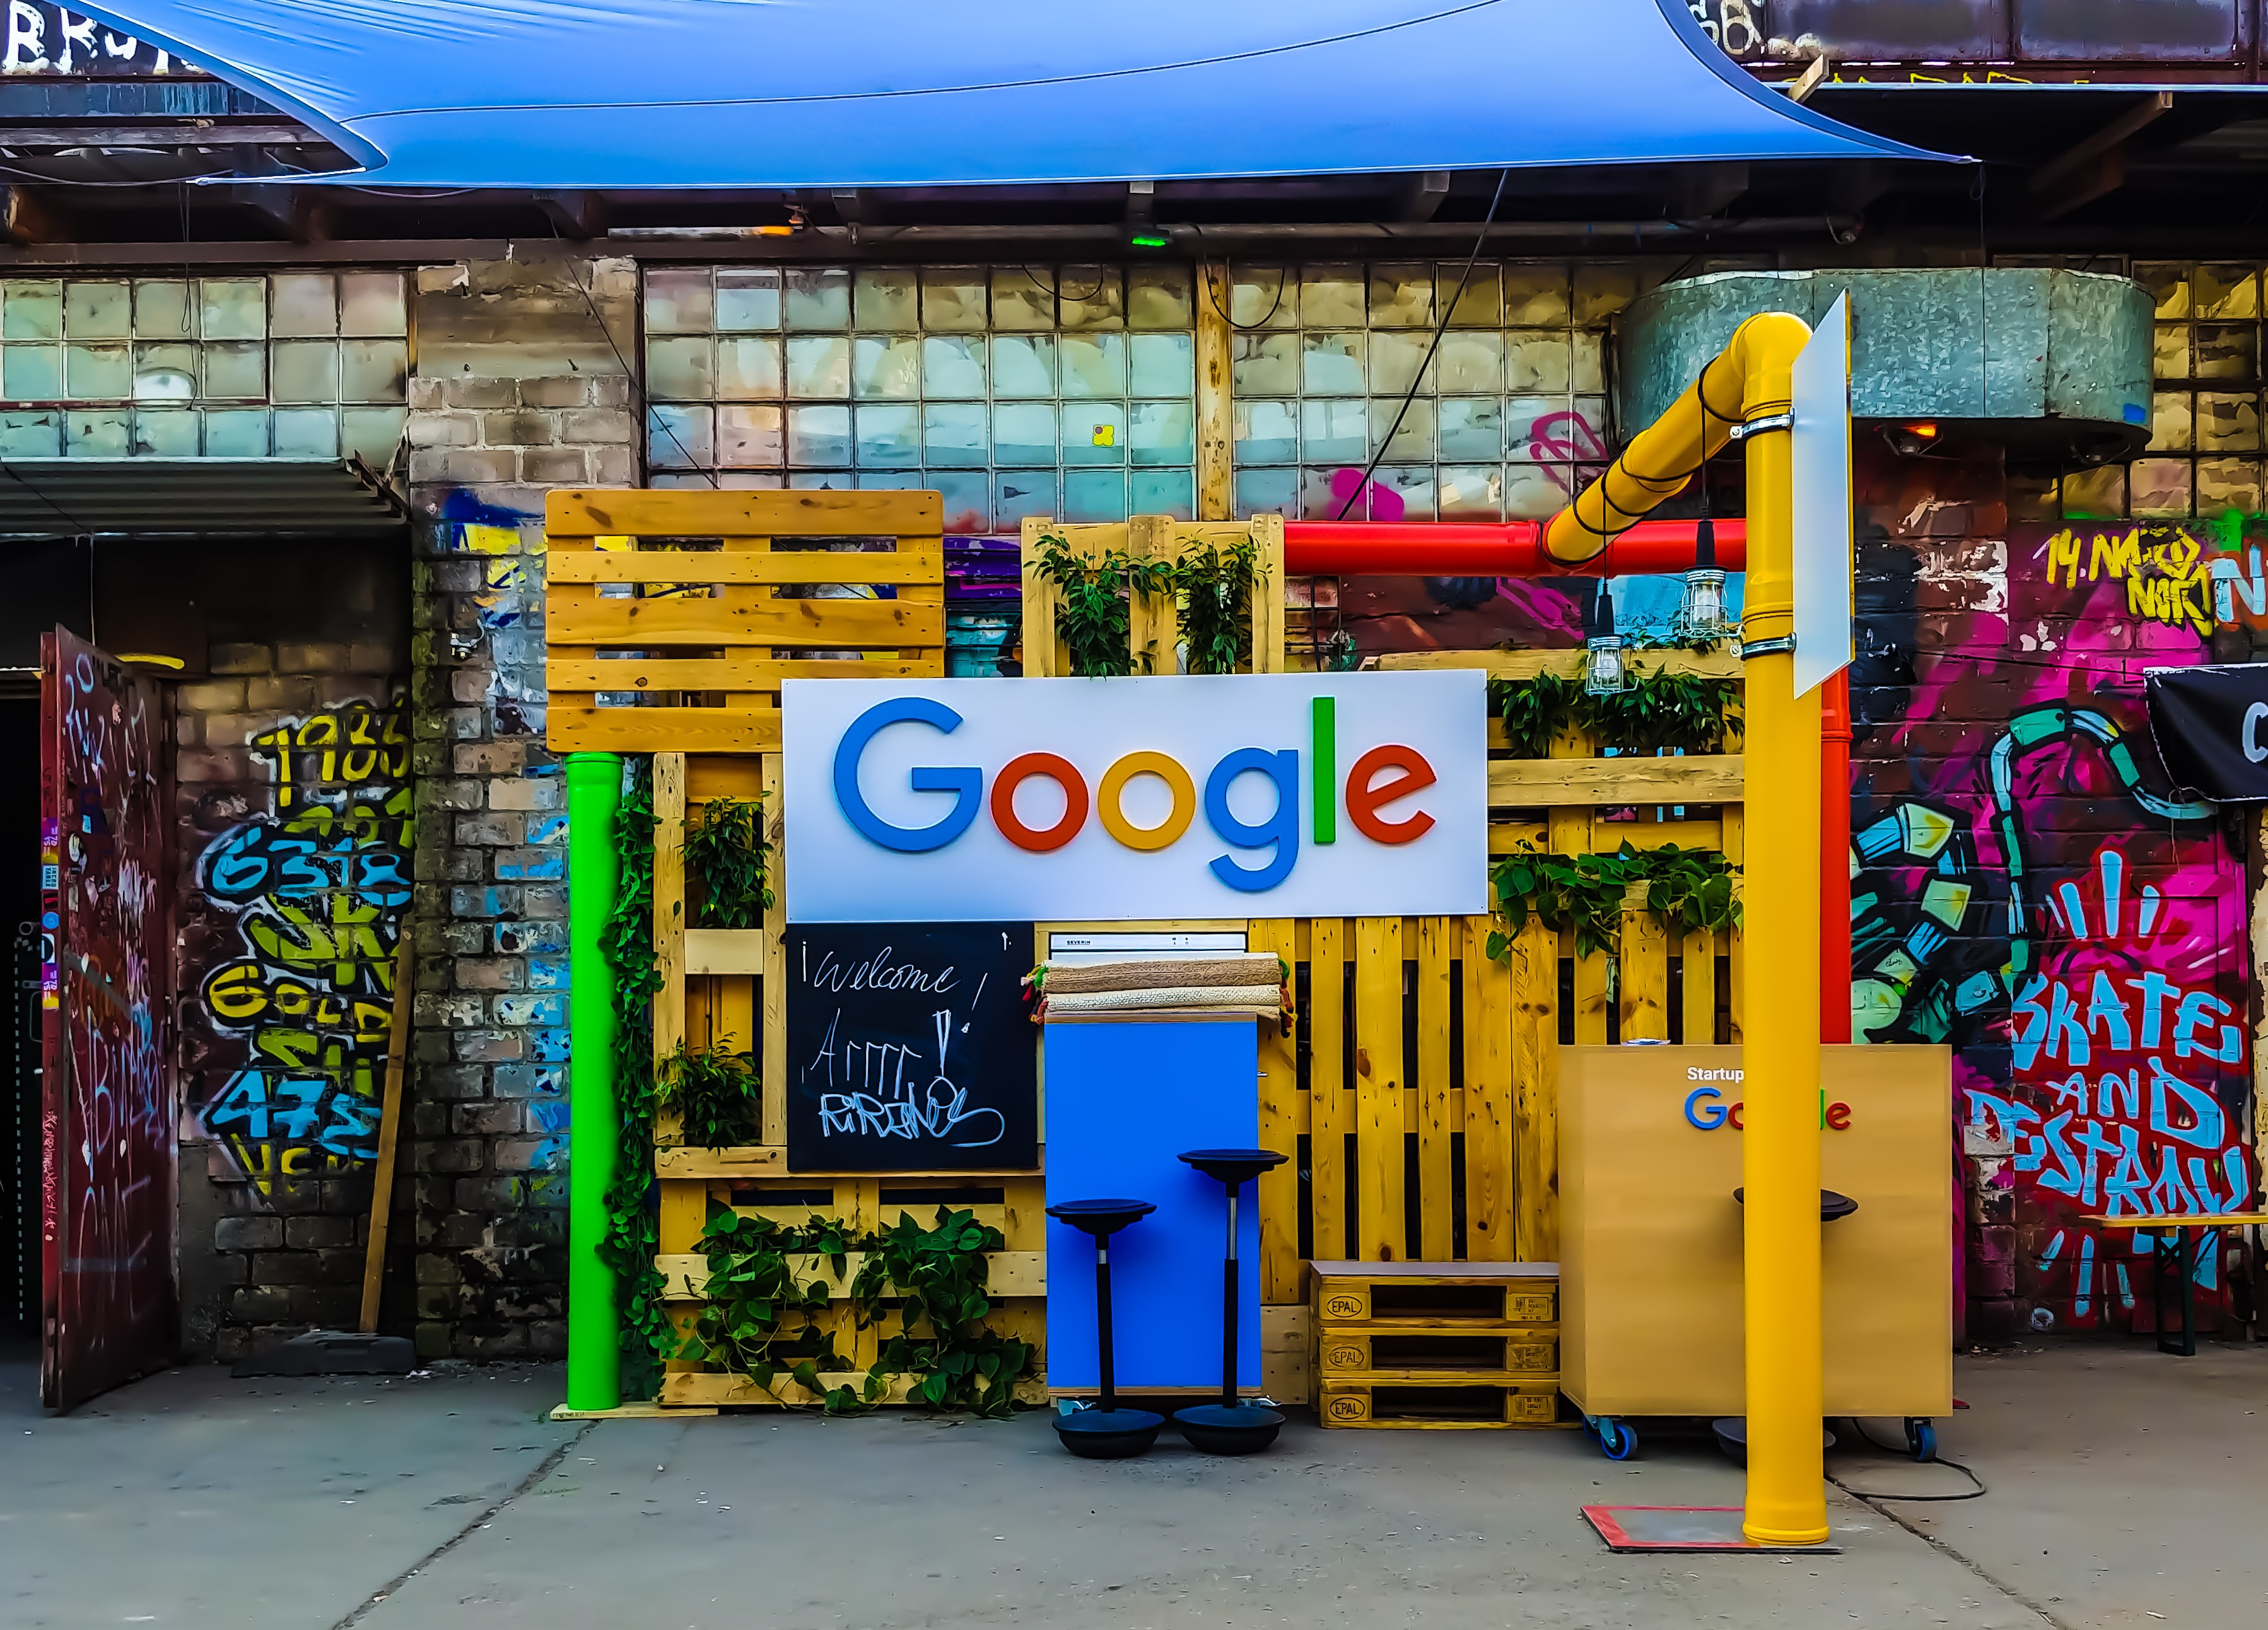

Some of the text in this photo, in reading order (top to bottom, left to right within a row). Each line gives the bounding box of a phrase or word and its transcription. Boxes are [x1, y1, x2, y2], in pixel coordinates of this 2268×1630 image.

[833, 696, 1437, 892] Google
[2011, 969, 2243, 1071] SKATE
[1687, 1066, 1745, 1083] Startup
[1685, 1086, 1852, 1130] Gole
[2045, 1056, 2225, 1149] AND
[1332, 1301, 1357, 1313] EPAL
[1335, 1351, 1359, 1363] EPAL
[1335, 1402, 1360, 1414] EPAL
